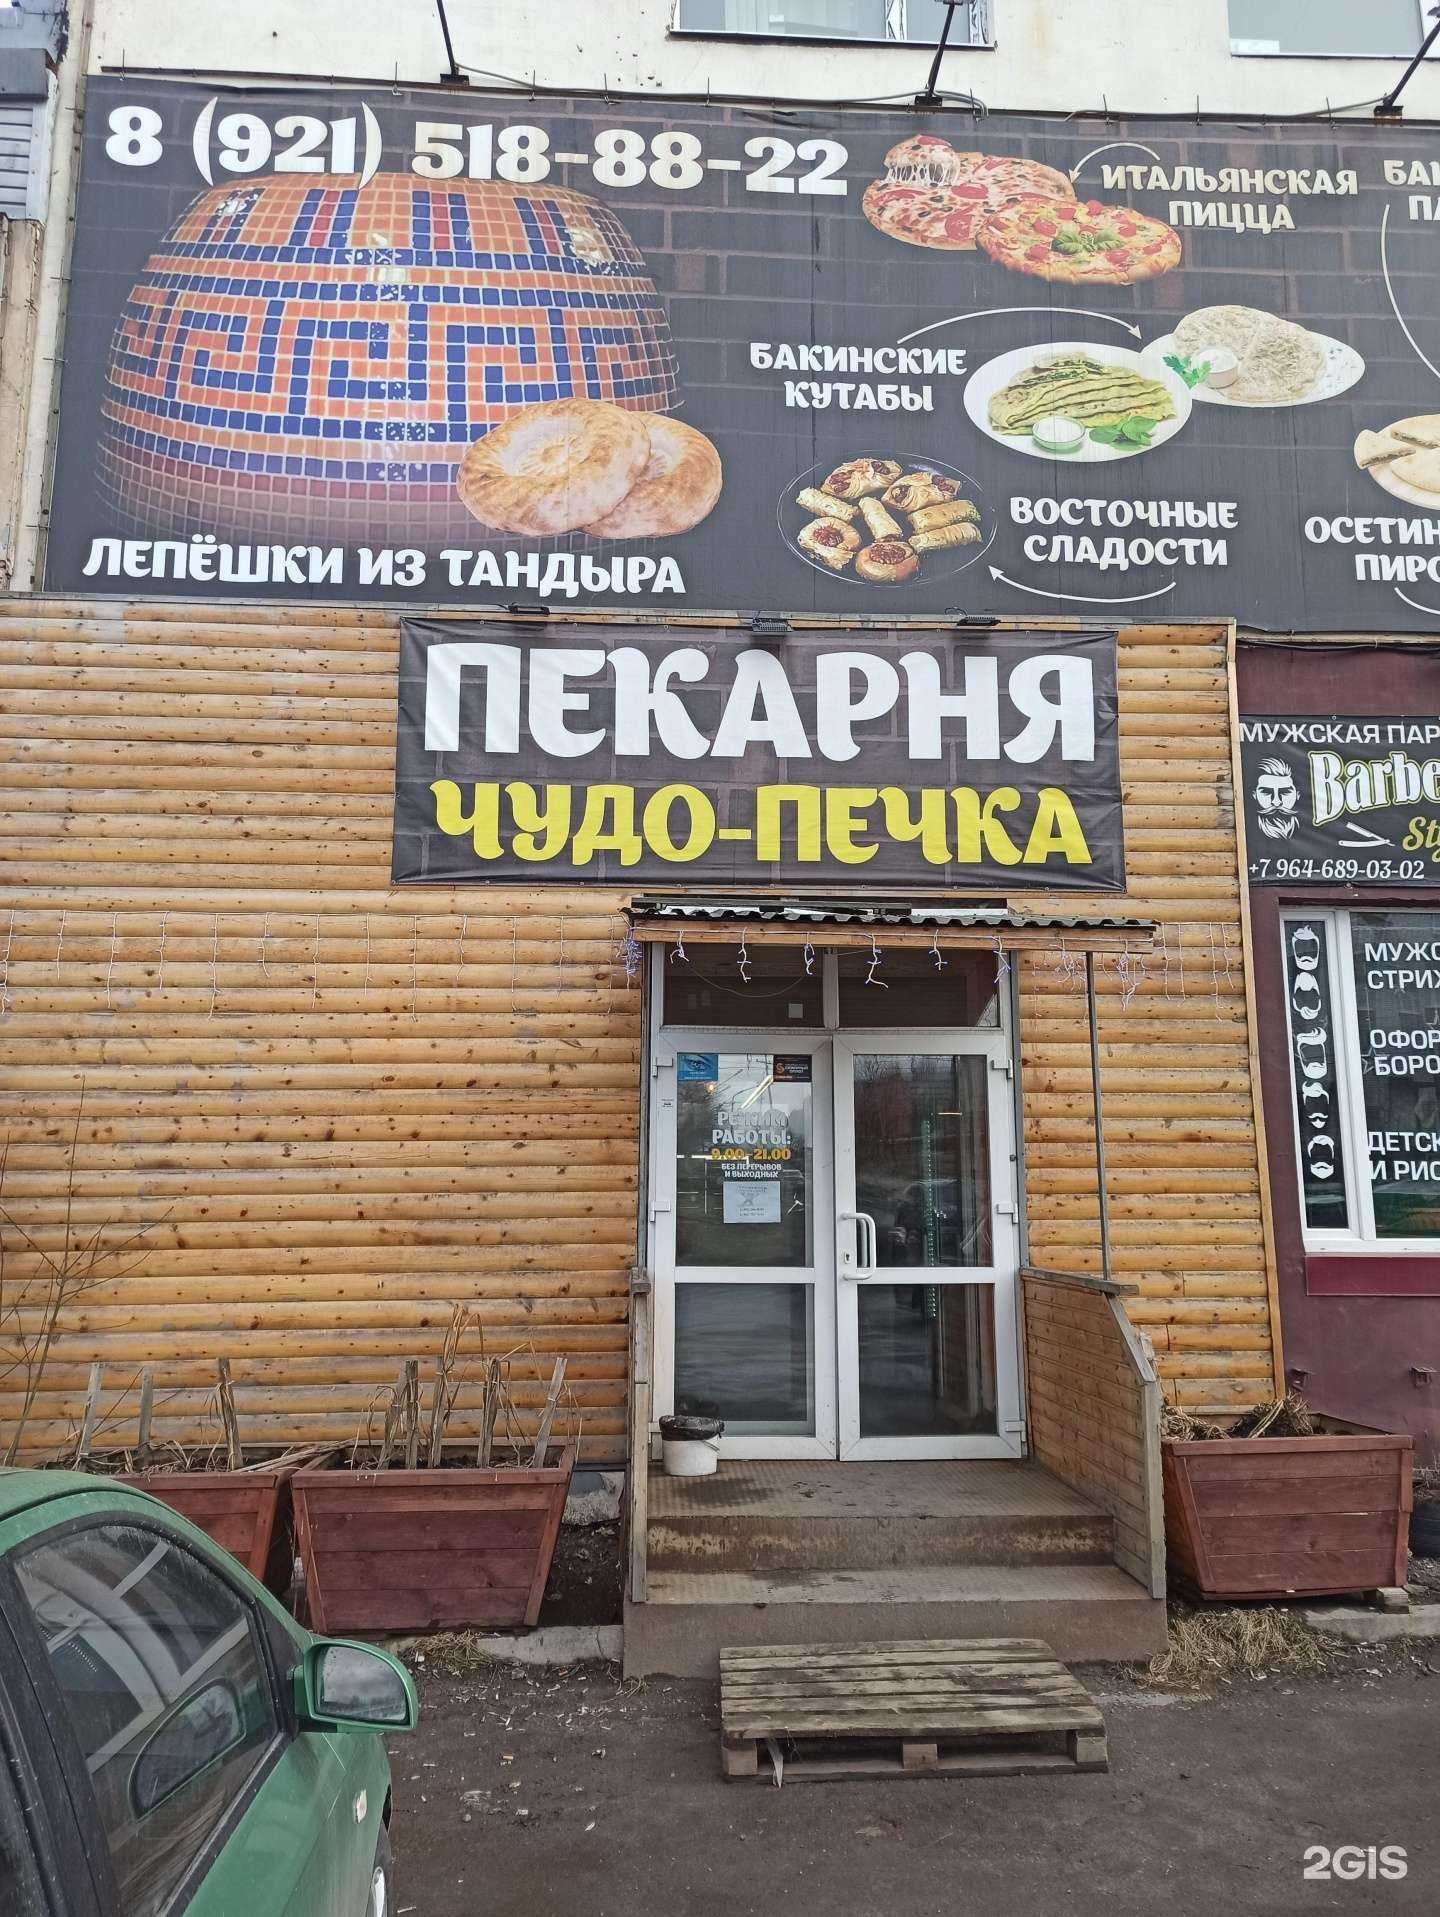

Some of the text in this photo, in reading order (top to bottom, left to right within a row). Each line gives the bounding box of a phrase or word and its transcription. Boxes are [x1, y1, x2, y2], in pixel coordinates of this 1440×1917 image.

[105, 96, 849, 196] 8 (921) 518-88-22
[1100, 164, 1358, 195] ИТАЛЬЯНСКАЯ
[1168, 199, 1296, 235] ПИЦЦА
[749, 342, 967, 375] БАКИНСКИЕ
[783, 380, 934, 412] КУТАБЫ
[1009, 496, 1239, 529] ВОСТОЧНЫЕ
[82, 533, 686, 598] ЛЕПЁШКИ ИЗ ТАНДЫРА
[1023, 534, 1229, 571] СЛАДОСТИ
[424, 642, 1095, 764] ПЕКАРНЯ
[1239, 722, 1379, 744] МУЖСКАЯ
[429, 779, 1093, 866] ЧУДО-ПЕЧКА
[1249, 858, 1425, 879] +7 964-689-03-02
[1367, 969, 1440, 990] СТРИ
[721, 1163, 782, 1171] БЕЗ ПЕРЕРЫВОВ
[724, 1170, 779, 1179] И ВЫХОДНЫХ
[1369, 1160, 1386, 1180] И
